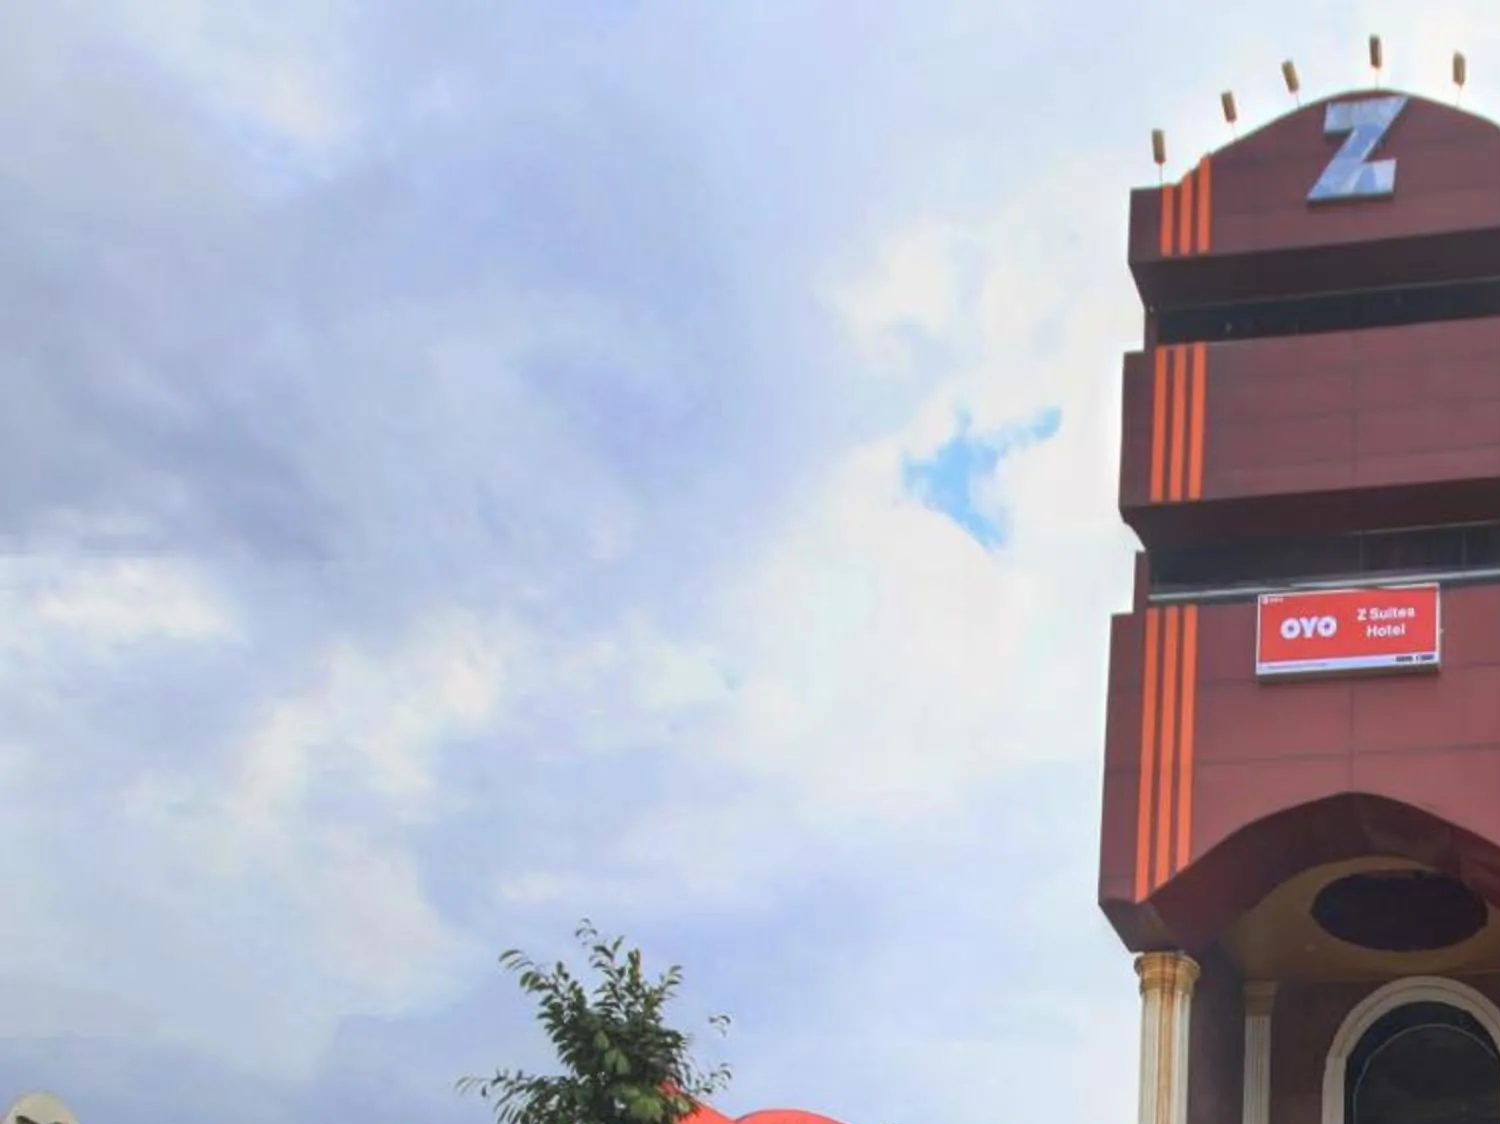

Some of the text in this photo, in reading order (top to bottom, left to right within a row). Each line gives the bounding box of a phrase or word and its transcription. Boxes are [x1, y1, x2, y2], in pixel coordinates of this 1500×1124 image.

[1306, 93, 1408, 202] Z
[1357, 607, 1416, 621] Z Suites
[1280, 616, 1337, 639] OYO
[1366, 623, 1406, 638] Hotel
